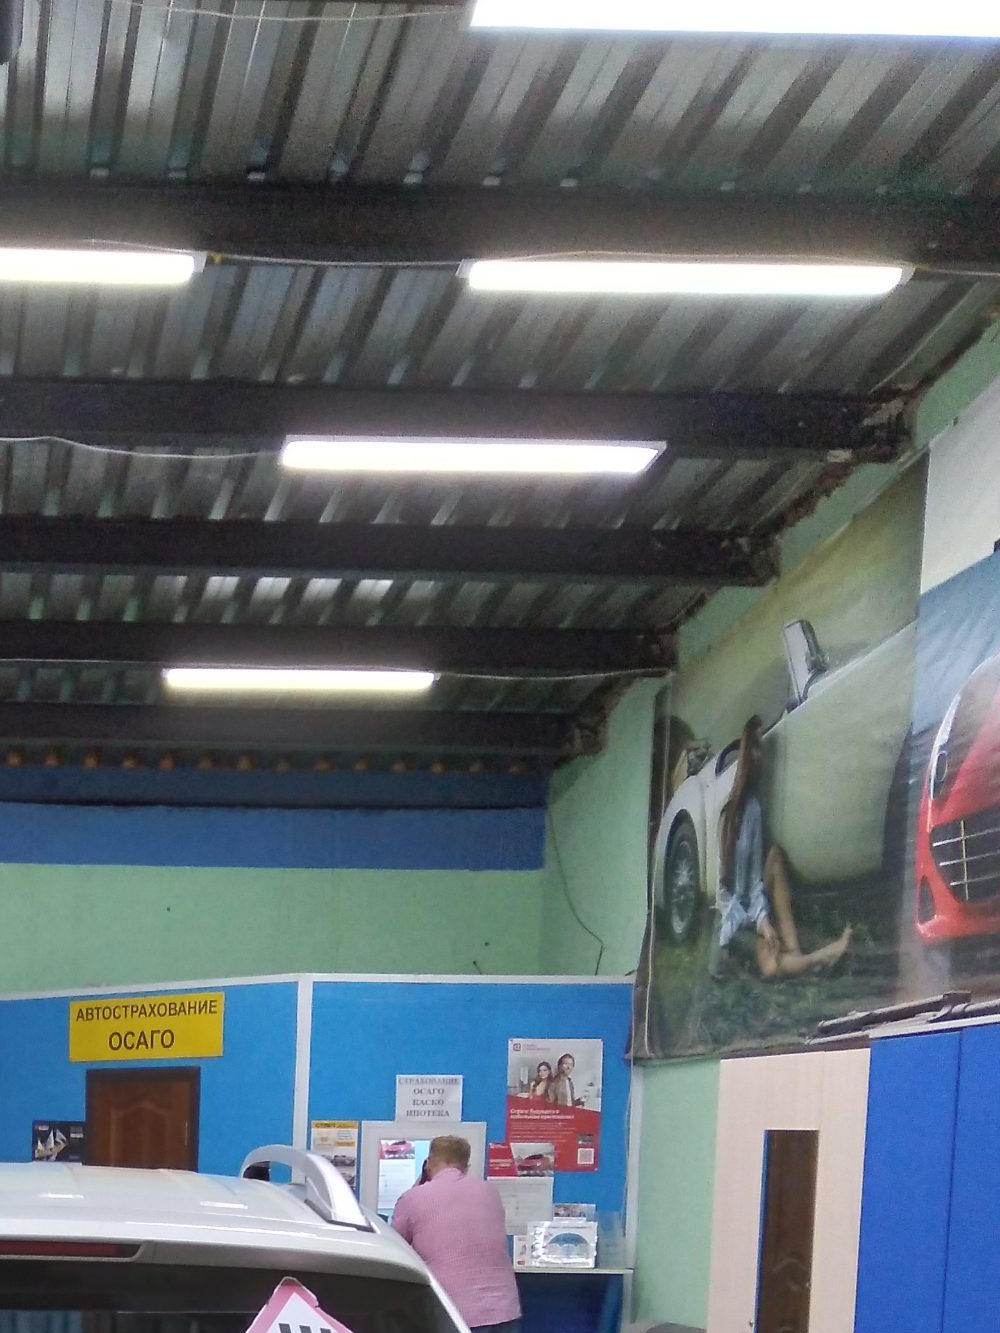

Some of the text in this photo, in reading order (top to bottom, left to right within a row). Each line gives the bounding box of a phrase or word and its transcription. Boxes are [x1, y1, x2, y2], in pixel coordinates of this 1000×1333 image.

[76, 1000, 218, 1022] АВТОСТРАХОВАНИЕ
[108, 1029, 175, 1051] ОСАГО
[413, 1087, 445, 1096] ОСАГО
